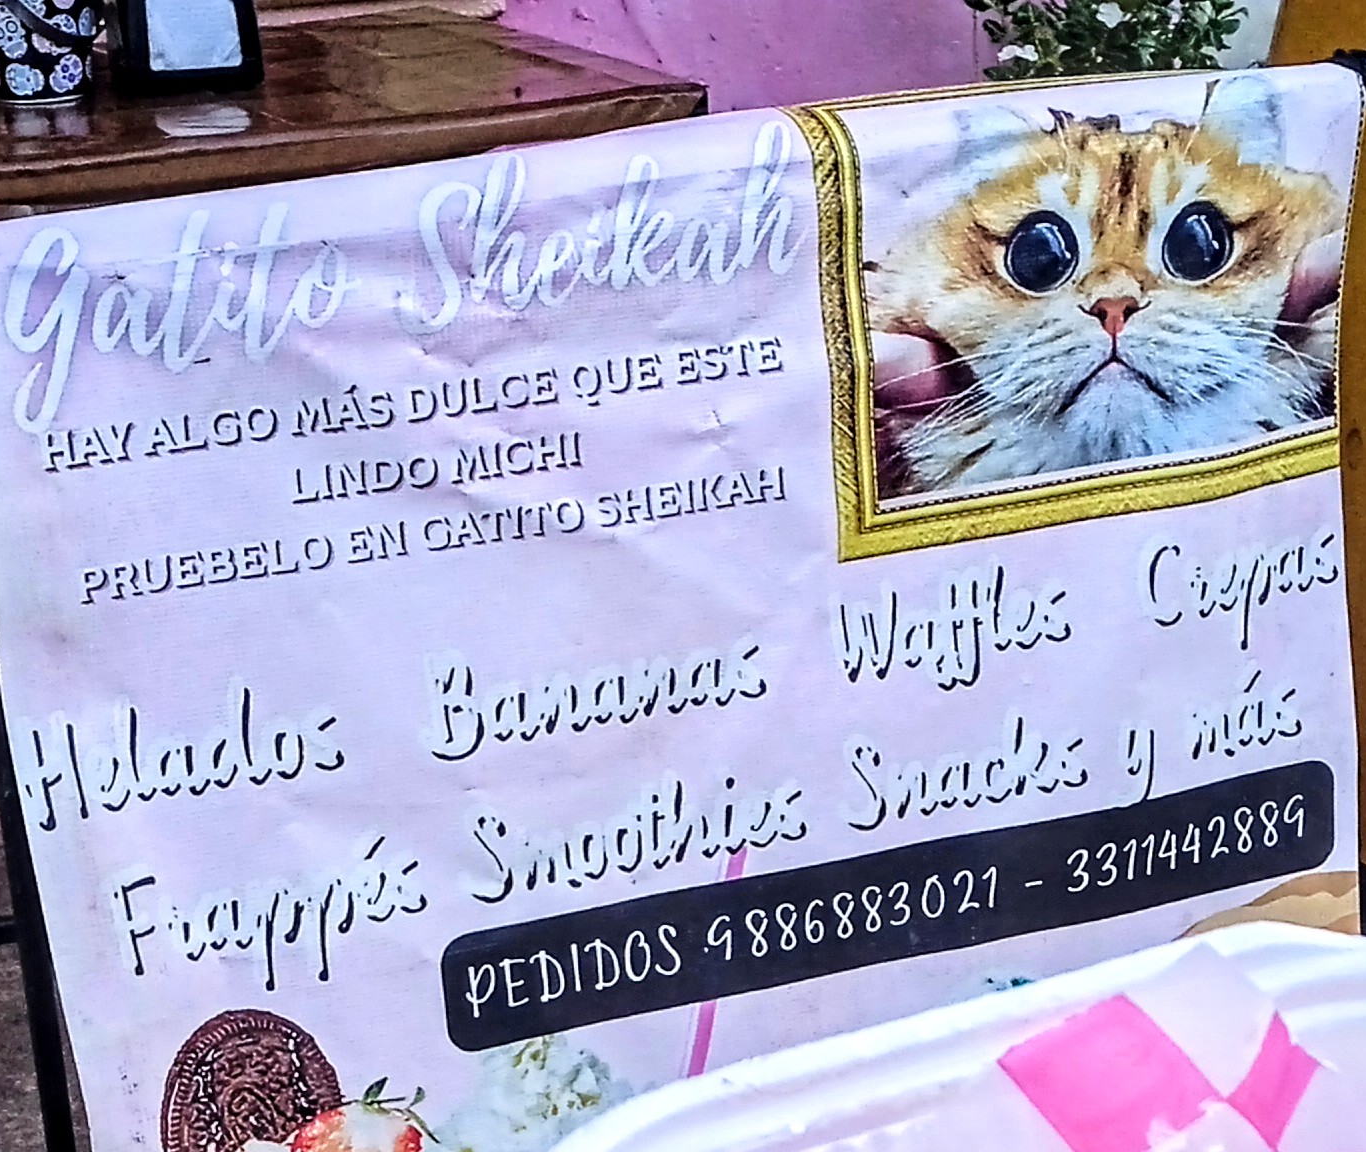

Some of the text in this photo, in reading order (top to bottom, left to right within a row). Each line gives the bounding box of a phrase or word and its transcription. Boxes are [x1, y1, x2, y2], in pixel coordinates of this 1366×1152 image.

[5, 118, 803, 436] Gatito Sheikah
[43, 336, 785, 473] HAY ALGO MÁS DULCE QUE ESTE
[289, 432, 585, 506] LINDO MICHI
[79, 464, 787, 606] PRUEBELO EN GATITO SHEIKAH
[20, 532, 1341, 833] Helados Bananas Waffles Crepas
[110, 660, 1305, 993] Frappés Smoothies Snacks y más
[463, 924, 683, 1018] PEDIDOS
[701, 864, 1001, 962] 9886883021
[1065, 793, 1307, 894] 3311442889
